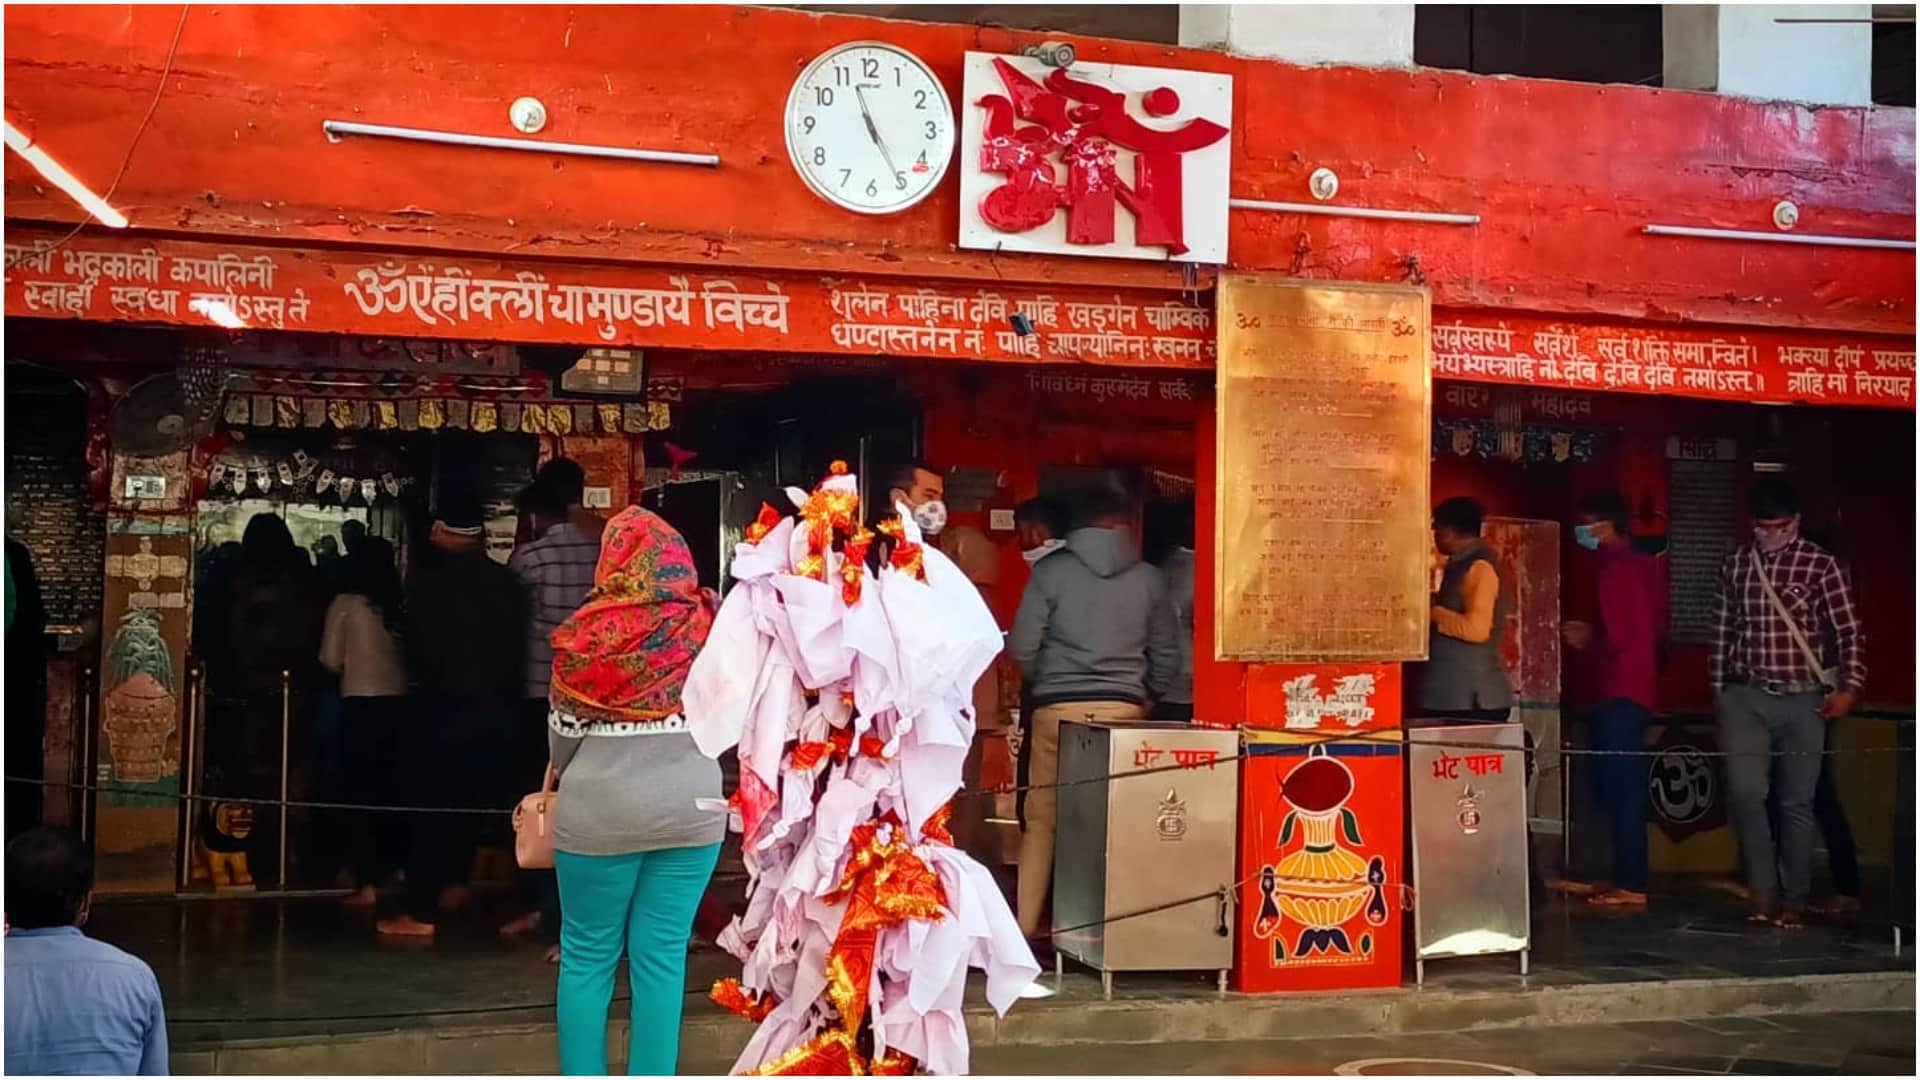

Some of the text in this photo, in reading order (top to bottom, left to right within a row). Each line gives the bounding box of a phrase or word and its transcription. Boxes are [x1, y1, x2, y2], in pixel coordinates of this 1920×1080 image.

[834, 66, 849, 87] 11
[861, 57, 880, 78] 12
[894, 66, 901, 87] 1
[814, 86, 834, 107] 10
[914, 89, 927, 110] 2
[803, 115, 816, 135] 9
[924, 120, 937, 140] 3
[814, 146, 826, 166] 8
[916, 149, 929, 165] 4
[840, 168, 852, 188] 7
[865, 178, 878, 197] 6
[895, 170, 907, 190] 5
[170, 253, 278, 290] कपालिनी
[1464, 753, 1505, 776] पात्र
